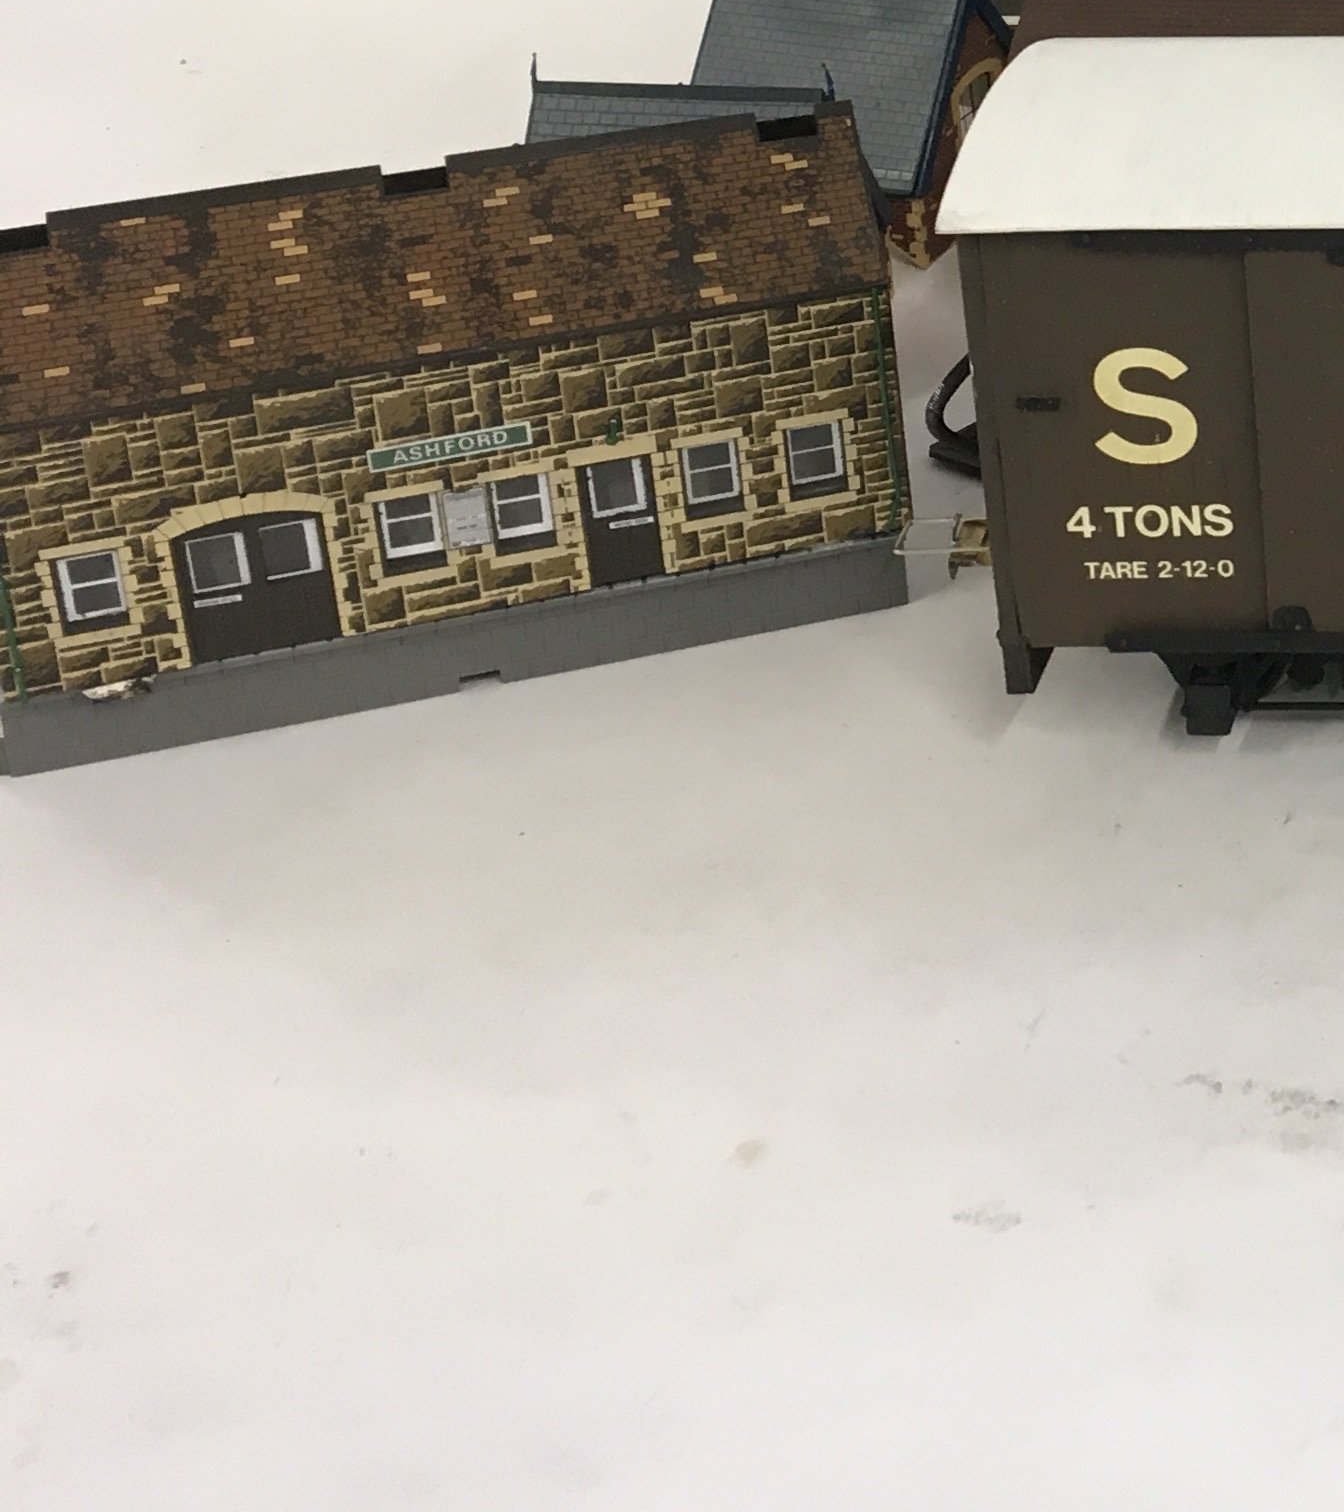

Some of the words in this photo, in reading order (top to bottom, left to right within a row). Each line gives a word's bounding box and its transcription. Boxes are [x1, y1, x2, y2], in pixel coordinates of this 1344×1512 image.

[1093, 347, 1198, 465] S
[393, 430, 508, 465] ASHFORD
[1066, 506, 1097, 539] 4
[1103, 503, 1234, 538] TONS
[1084, 561, 1149, 580] TARE
[1157, 559, 1235, 579] 2-12-0
